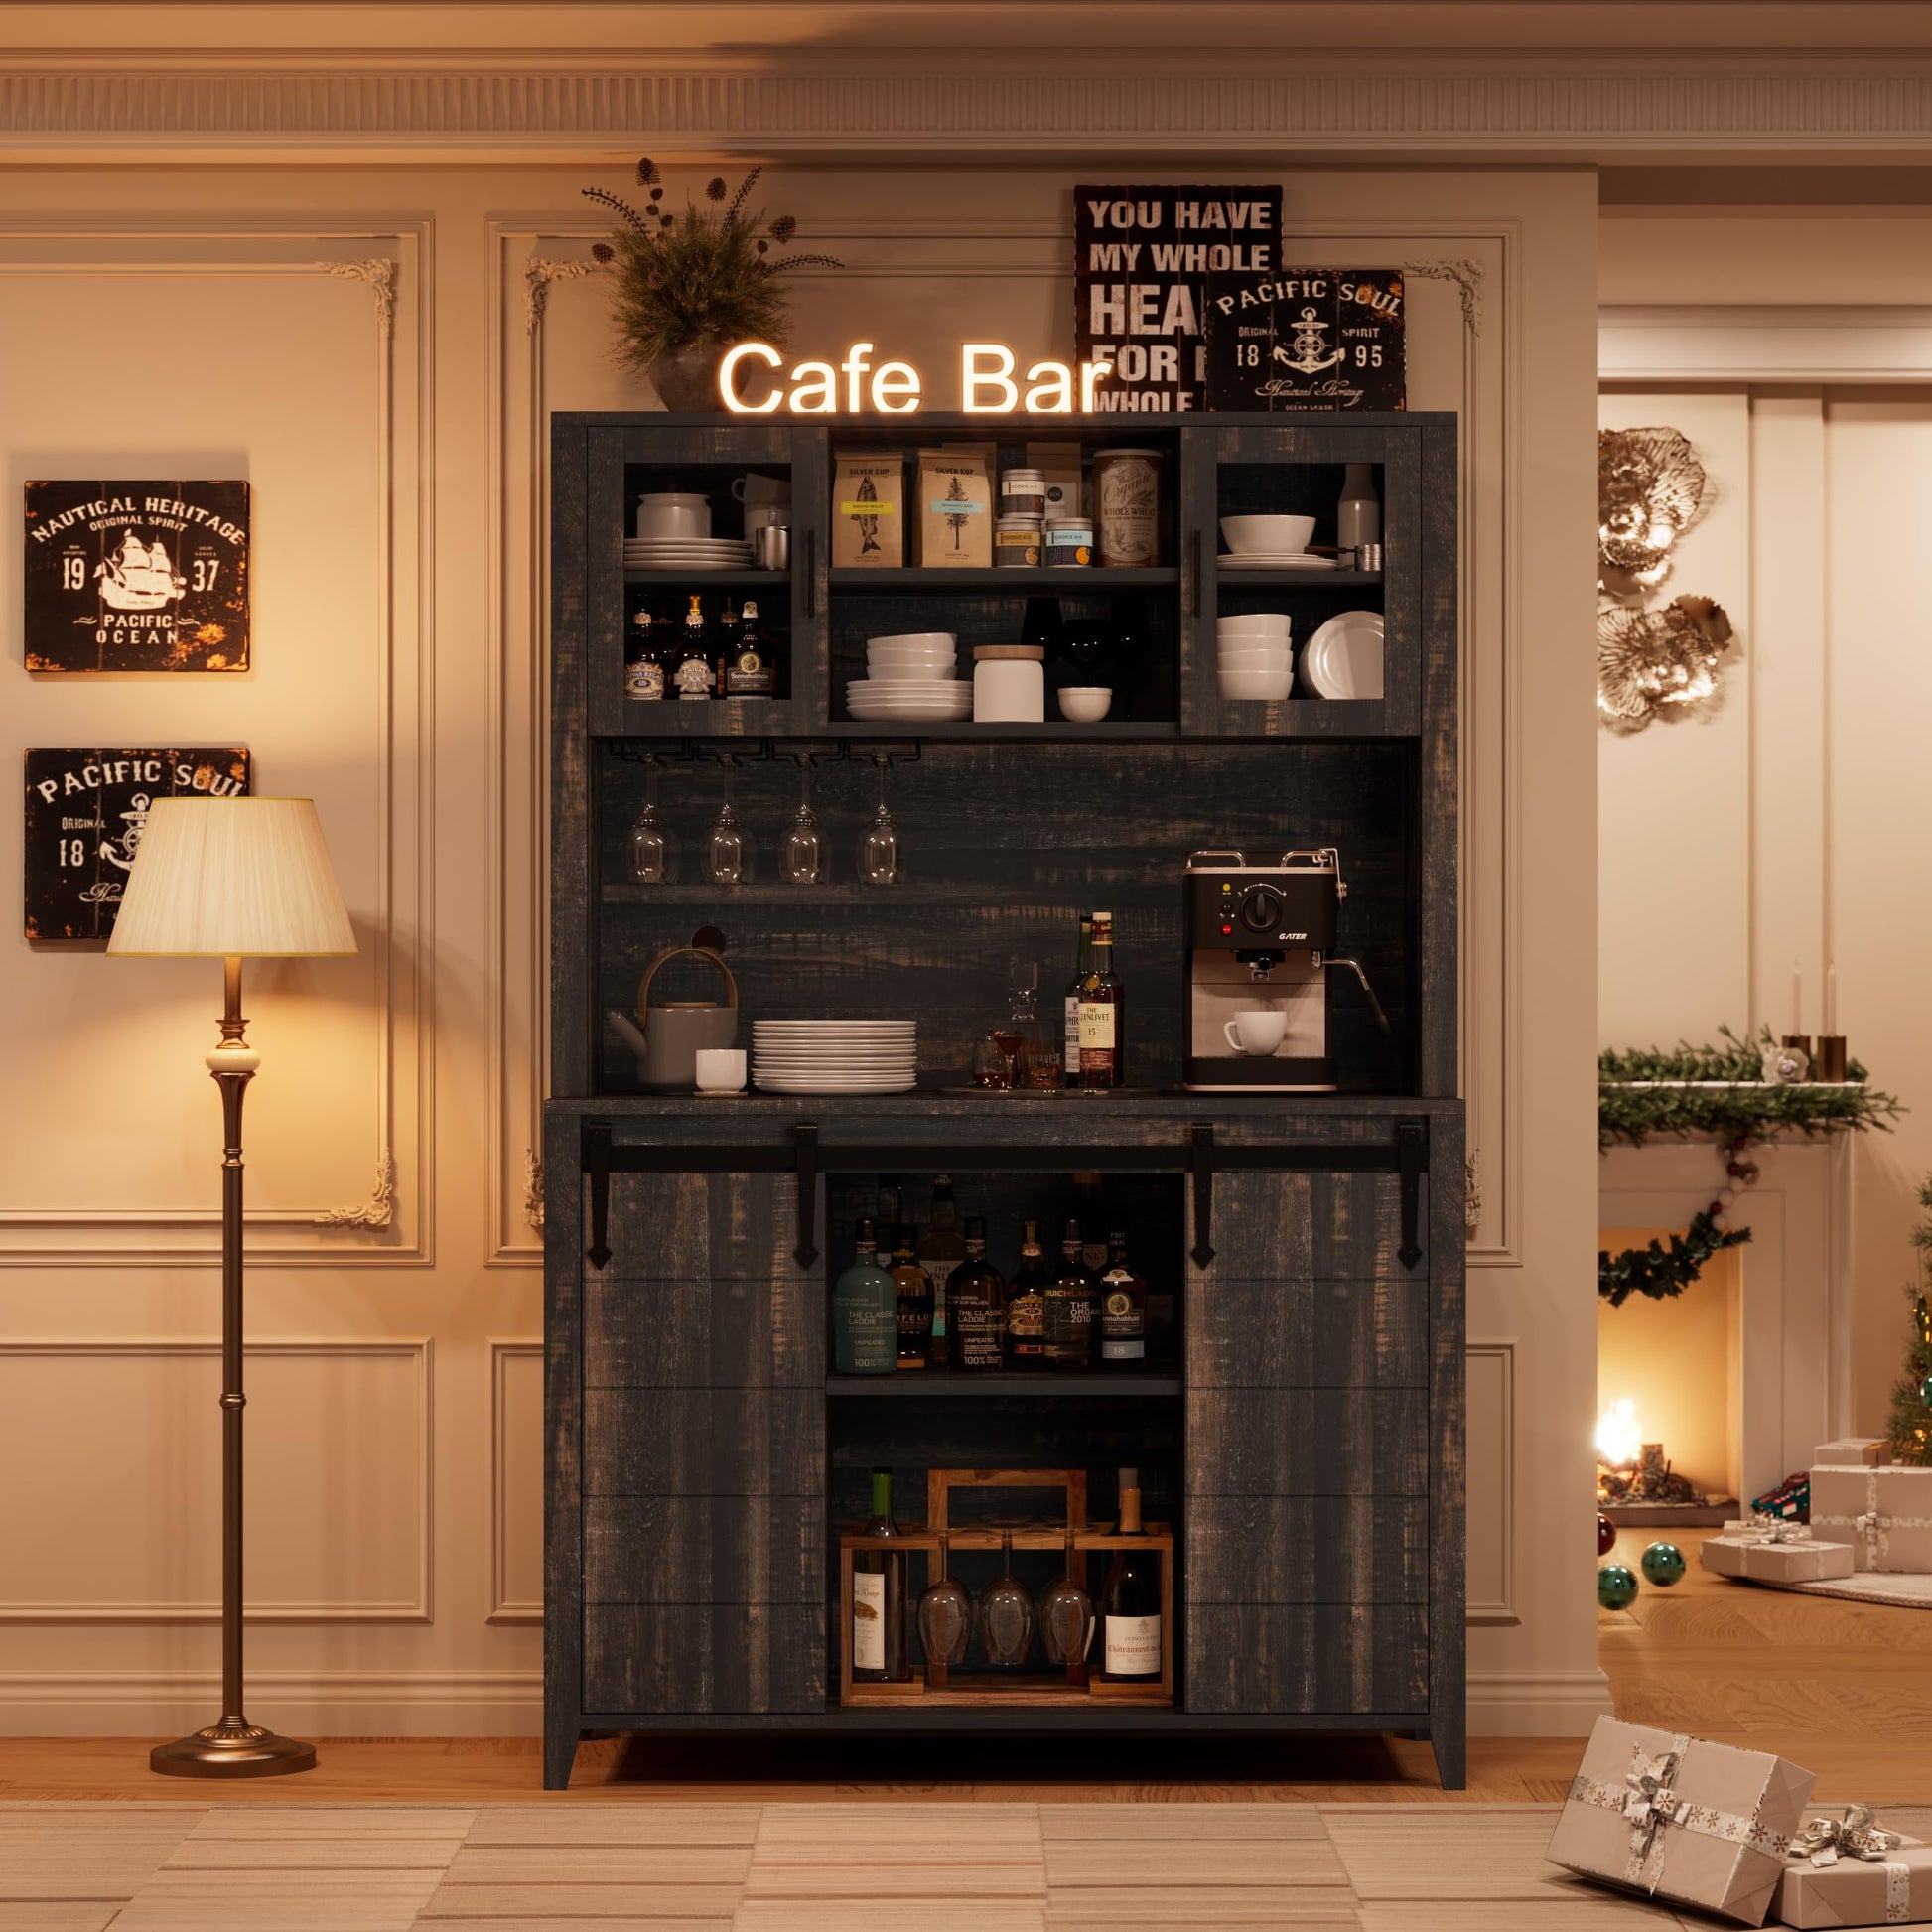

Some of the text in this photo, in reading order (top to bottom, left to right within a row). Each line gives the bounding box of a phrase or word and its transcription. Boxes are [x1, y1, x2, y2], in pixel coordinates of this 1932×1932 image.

[1087, 201, 1272, 230] YOU HAVE
[1090, 244, 1270, 272] MY WHOLE
[1090, 284, 1204, 336] HEA
[1216, 280, 1402, 317] PACIFIC SOUL
[1238, 326, 1381, 339] ORIGINAL SPIRIT
[1093, 345, 1178, 382] FOR
[1236, 344, 1383, 368] 18 95
[719, 342, 921, 413] Cafe
[961, 343, 1112, 413] Bar
[31, 497, 246, 546] NAUTICAL HERITAGE
[88, 515, 189, 533] ORIGINAL SPIRIT
[1103, 507, 1130, 517] WHOLE
[62, 557, 86, 591] 19
[192, 559, 220, 593] 37
[103, 614, 173, 628] PACIFIC
[95, 630, 179, 645] OCEAN
[36, 760, 162, 804] PACIFIC
[61, 816, 107, 831] ORIGINAL
[58, 838, 85, 868] 18
[1070, 1301, 1090, 1310] THE
[1070, 1315, 1091, 1324] 2010
[855, 1358, 877, 1367] 100%
[964, 1356, 986, 1365] 100%
